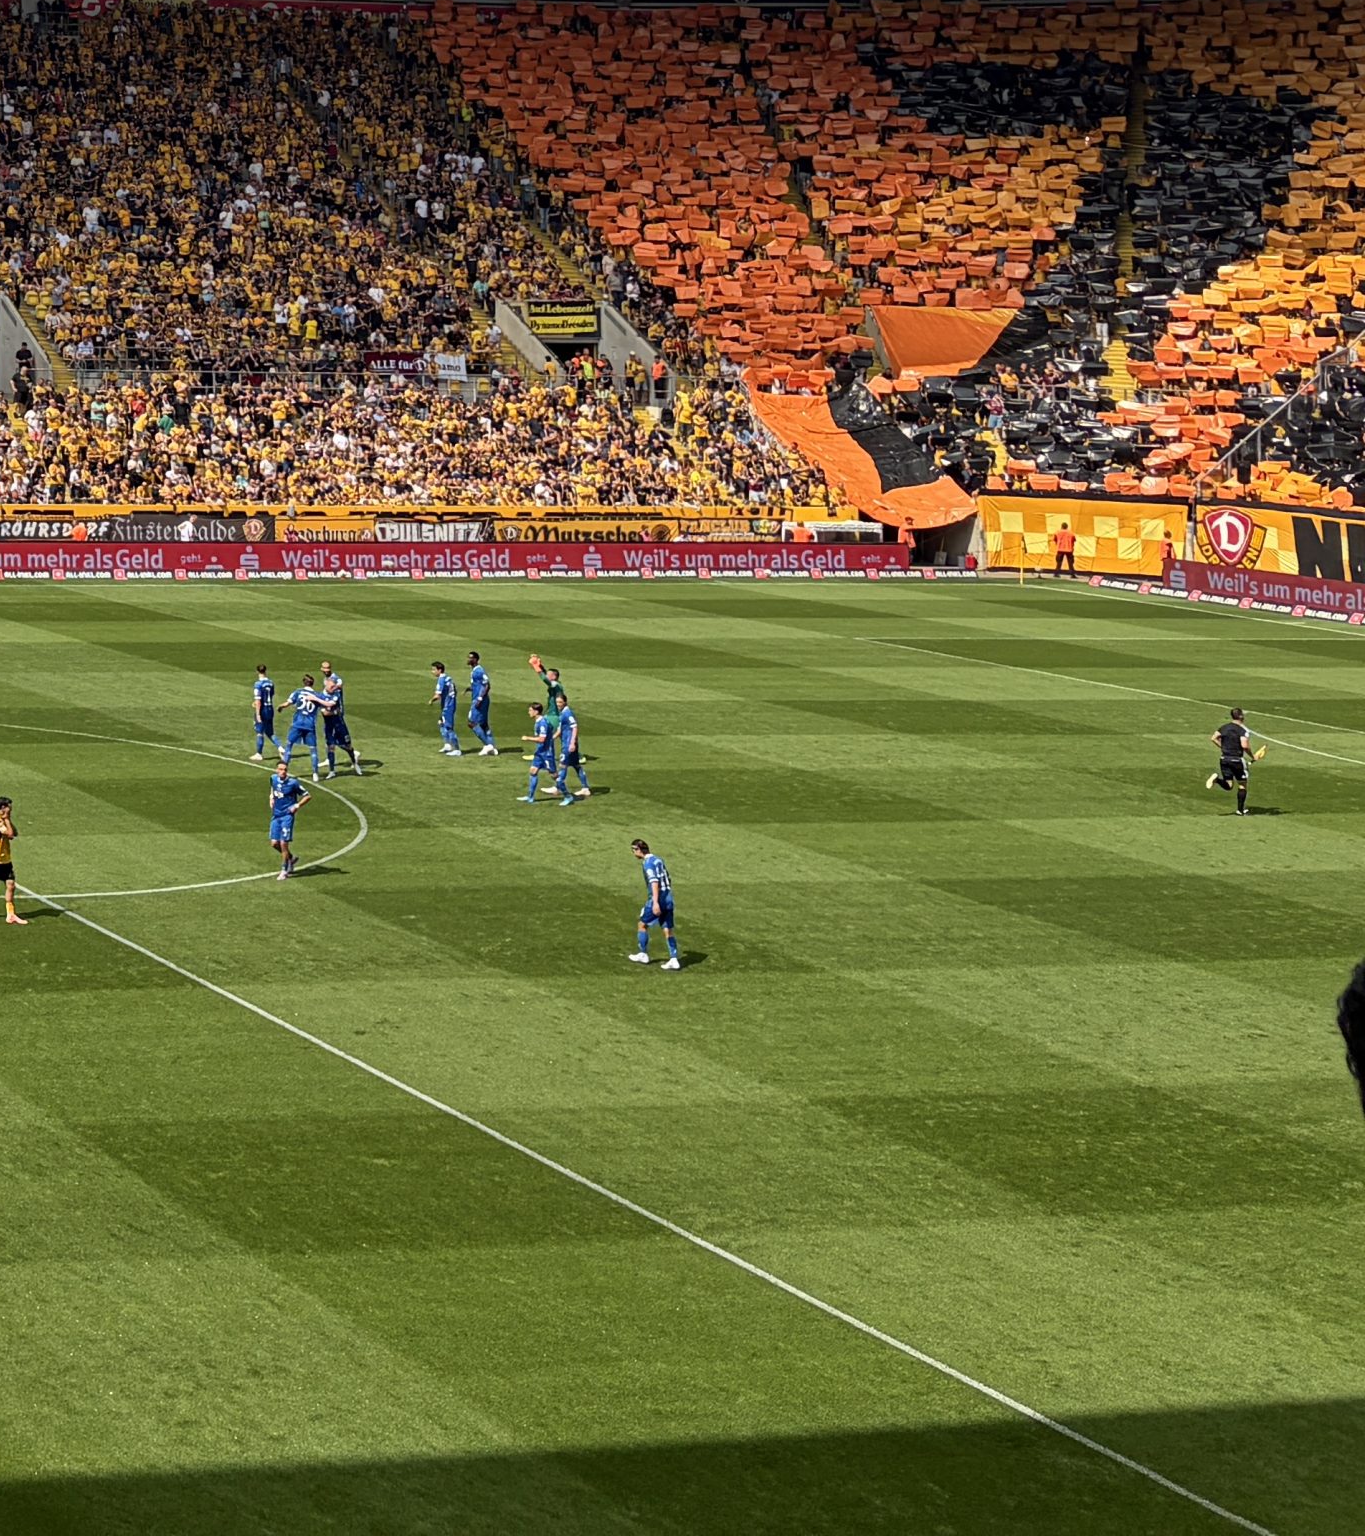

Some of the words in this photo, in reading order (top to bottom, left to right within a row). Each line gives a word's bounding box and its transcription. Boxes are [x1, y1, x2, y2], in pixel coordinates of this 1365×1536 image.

[524, 523, 643, 542] Mutzsche
[28, 549, 80, 569] mehr
[84, 549, 115, 569] als
[114, 549, 163, 569] Geld
[282, 549, 342, 568] Weil's
[343, 555, 375, 568] um
[381, 550, 430, 568] mehr
[434, 549, 462, 568] als
[465, 549, 509, 568] Geld
[623, 549, 680, 569] Weil's
[685, 555, 713, 569] um
[719, 550, 770, 569] mehr
[771, 549, 799, 568] als
[801, 550, 845, 569] Geld
[1207, 571, 1258, 595] Weil's
[1263, 582, 1290, 599] um
[1295, 585, 1343, 607] mehr
